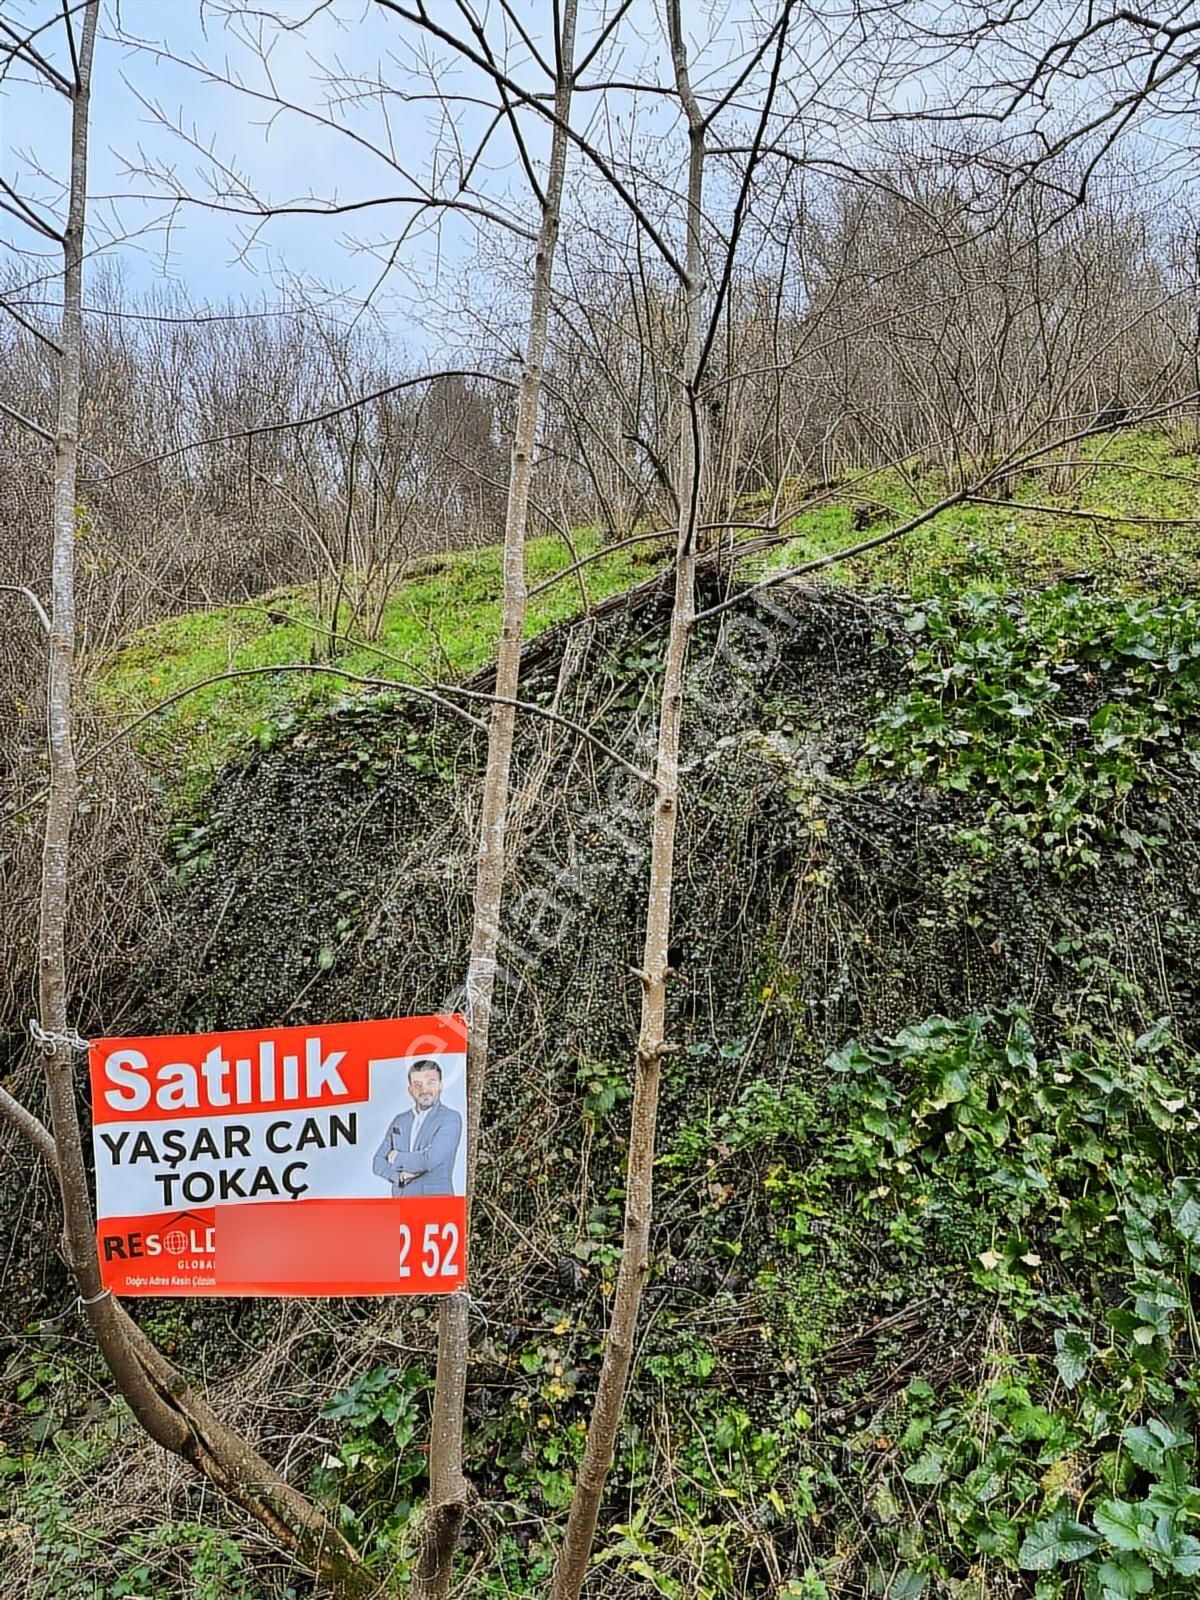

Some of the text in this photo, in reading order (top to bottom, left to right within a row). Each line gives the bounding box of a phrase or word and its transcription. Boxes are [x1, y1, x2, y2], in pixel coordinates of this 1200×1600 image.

[104, 1037, 349, 1112] Satılık
[100, 1112, 357, 1169] YAŞAR CAN
[154, 1161, 309, 1206] TOKAÇ
[178, 1260, 215, 1270] GLOBA
[422, 1222, 459, 1277] 52
